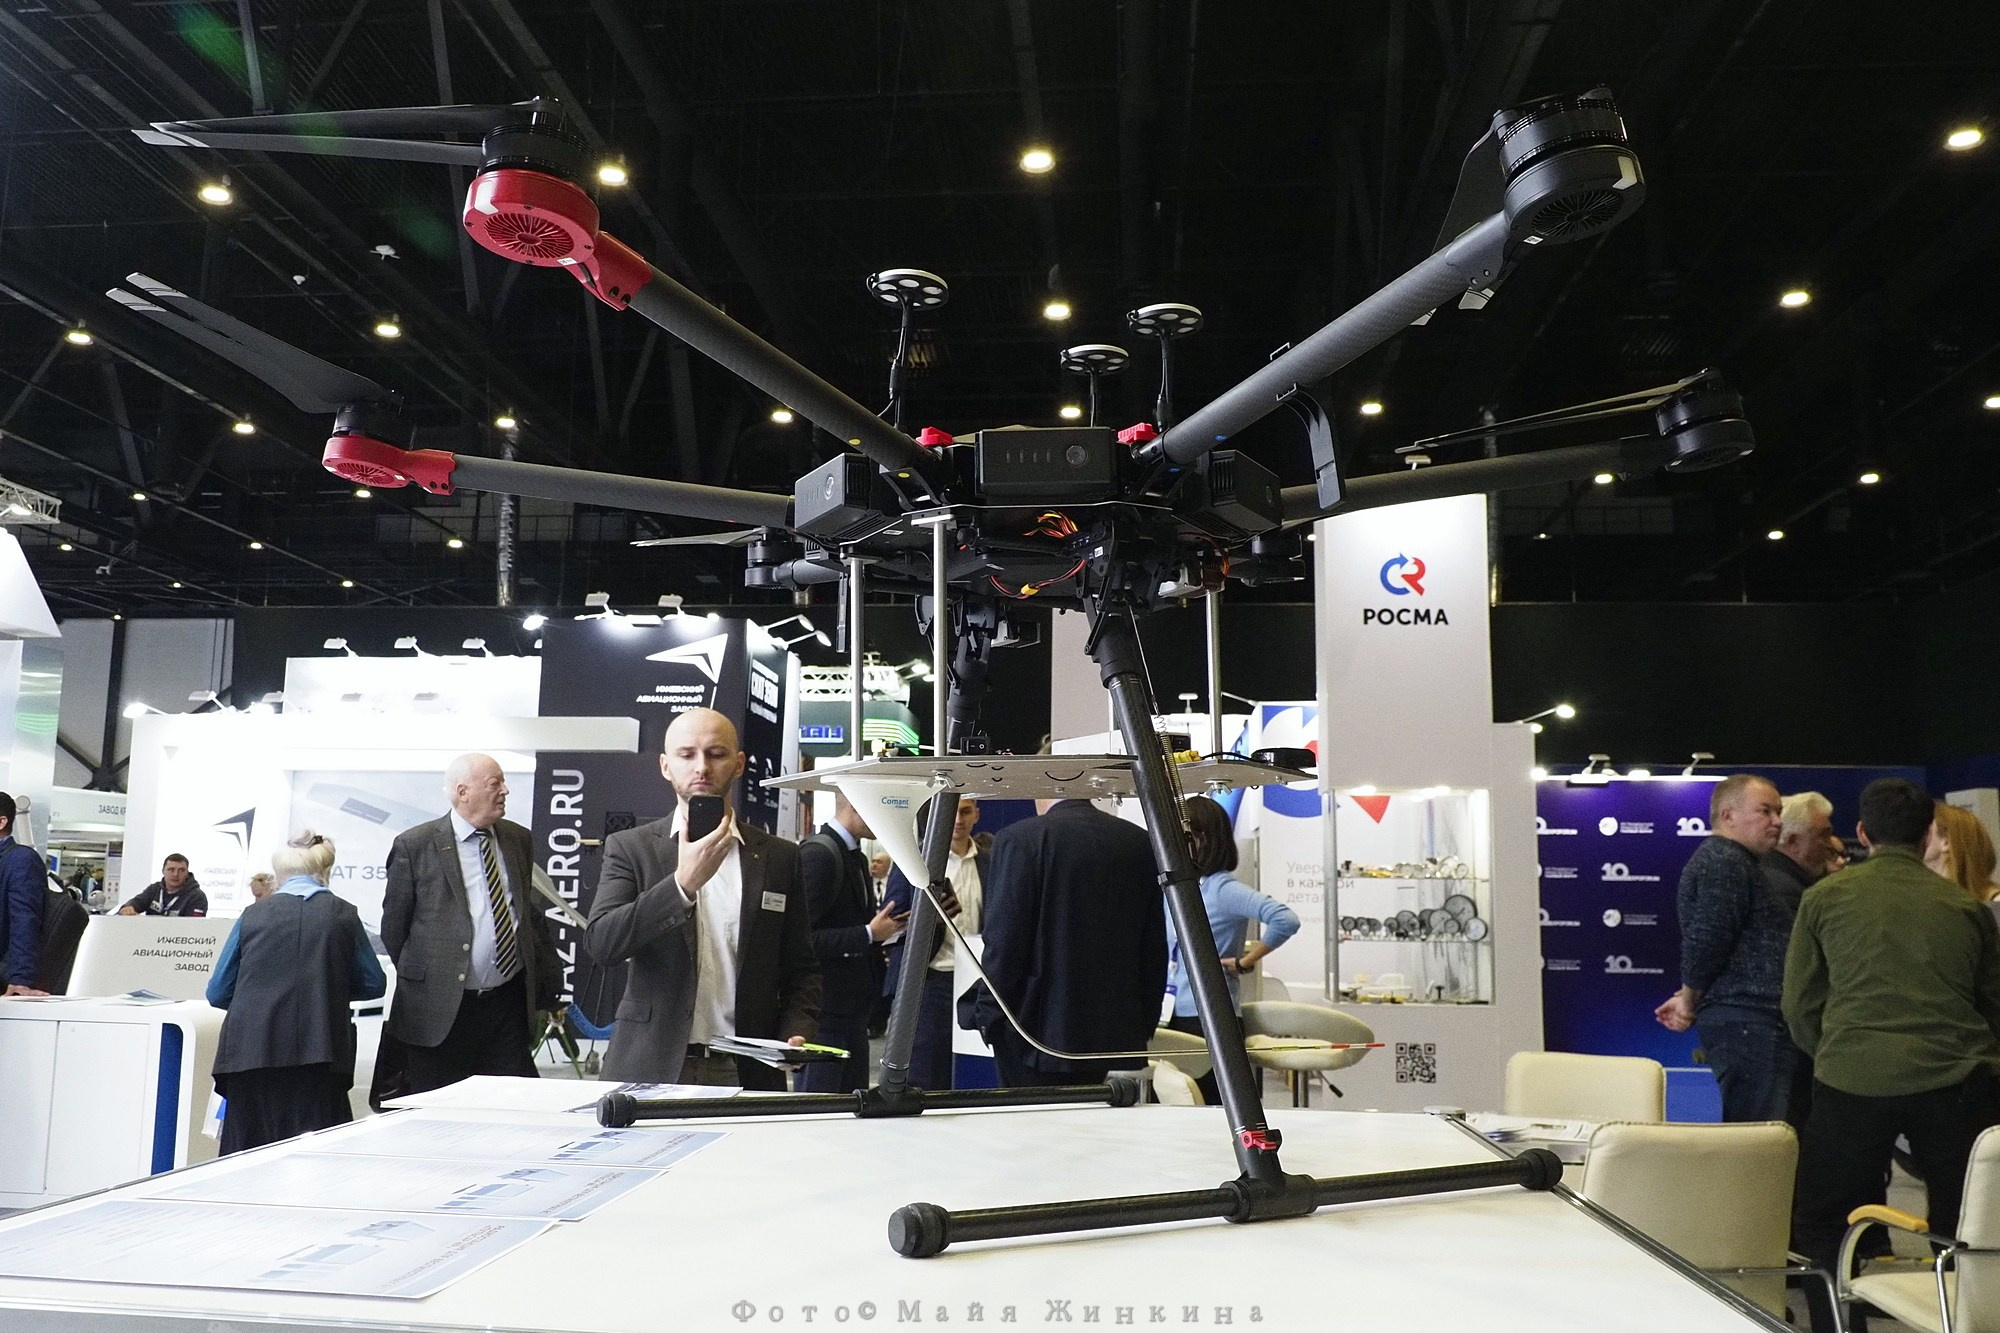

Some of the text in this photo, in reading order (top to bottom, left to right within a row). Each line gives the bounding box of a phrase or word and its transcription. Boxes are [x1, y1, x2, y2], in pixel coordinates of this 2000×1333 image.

[1363, 608, 1449, 626] РОСМА
[1286, 862, 1324, 877] Увер
[157, 936, 217, 945] ИЖЕВСКИЙ
[132, 948, 213, 958] АВИАЦИОННЫЙ
[174, 963, 210, 972] ЗАВОД
